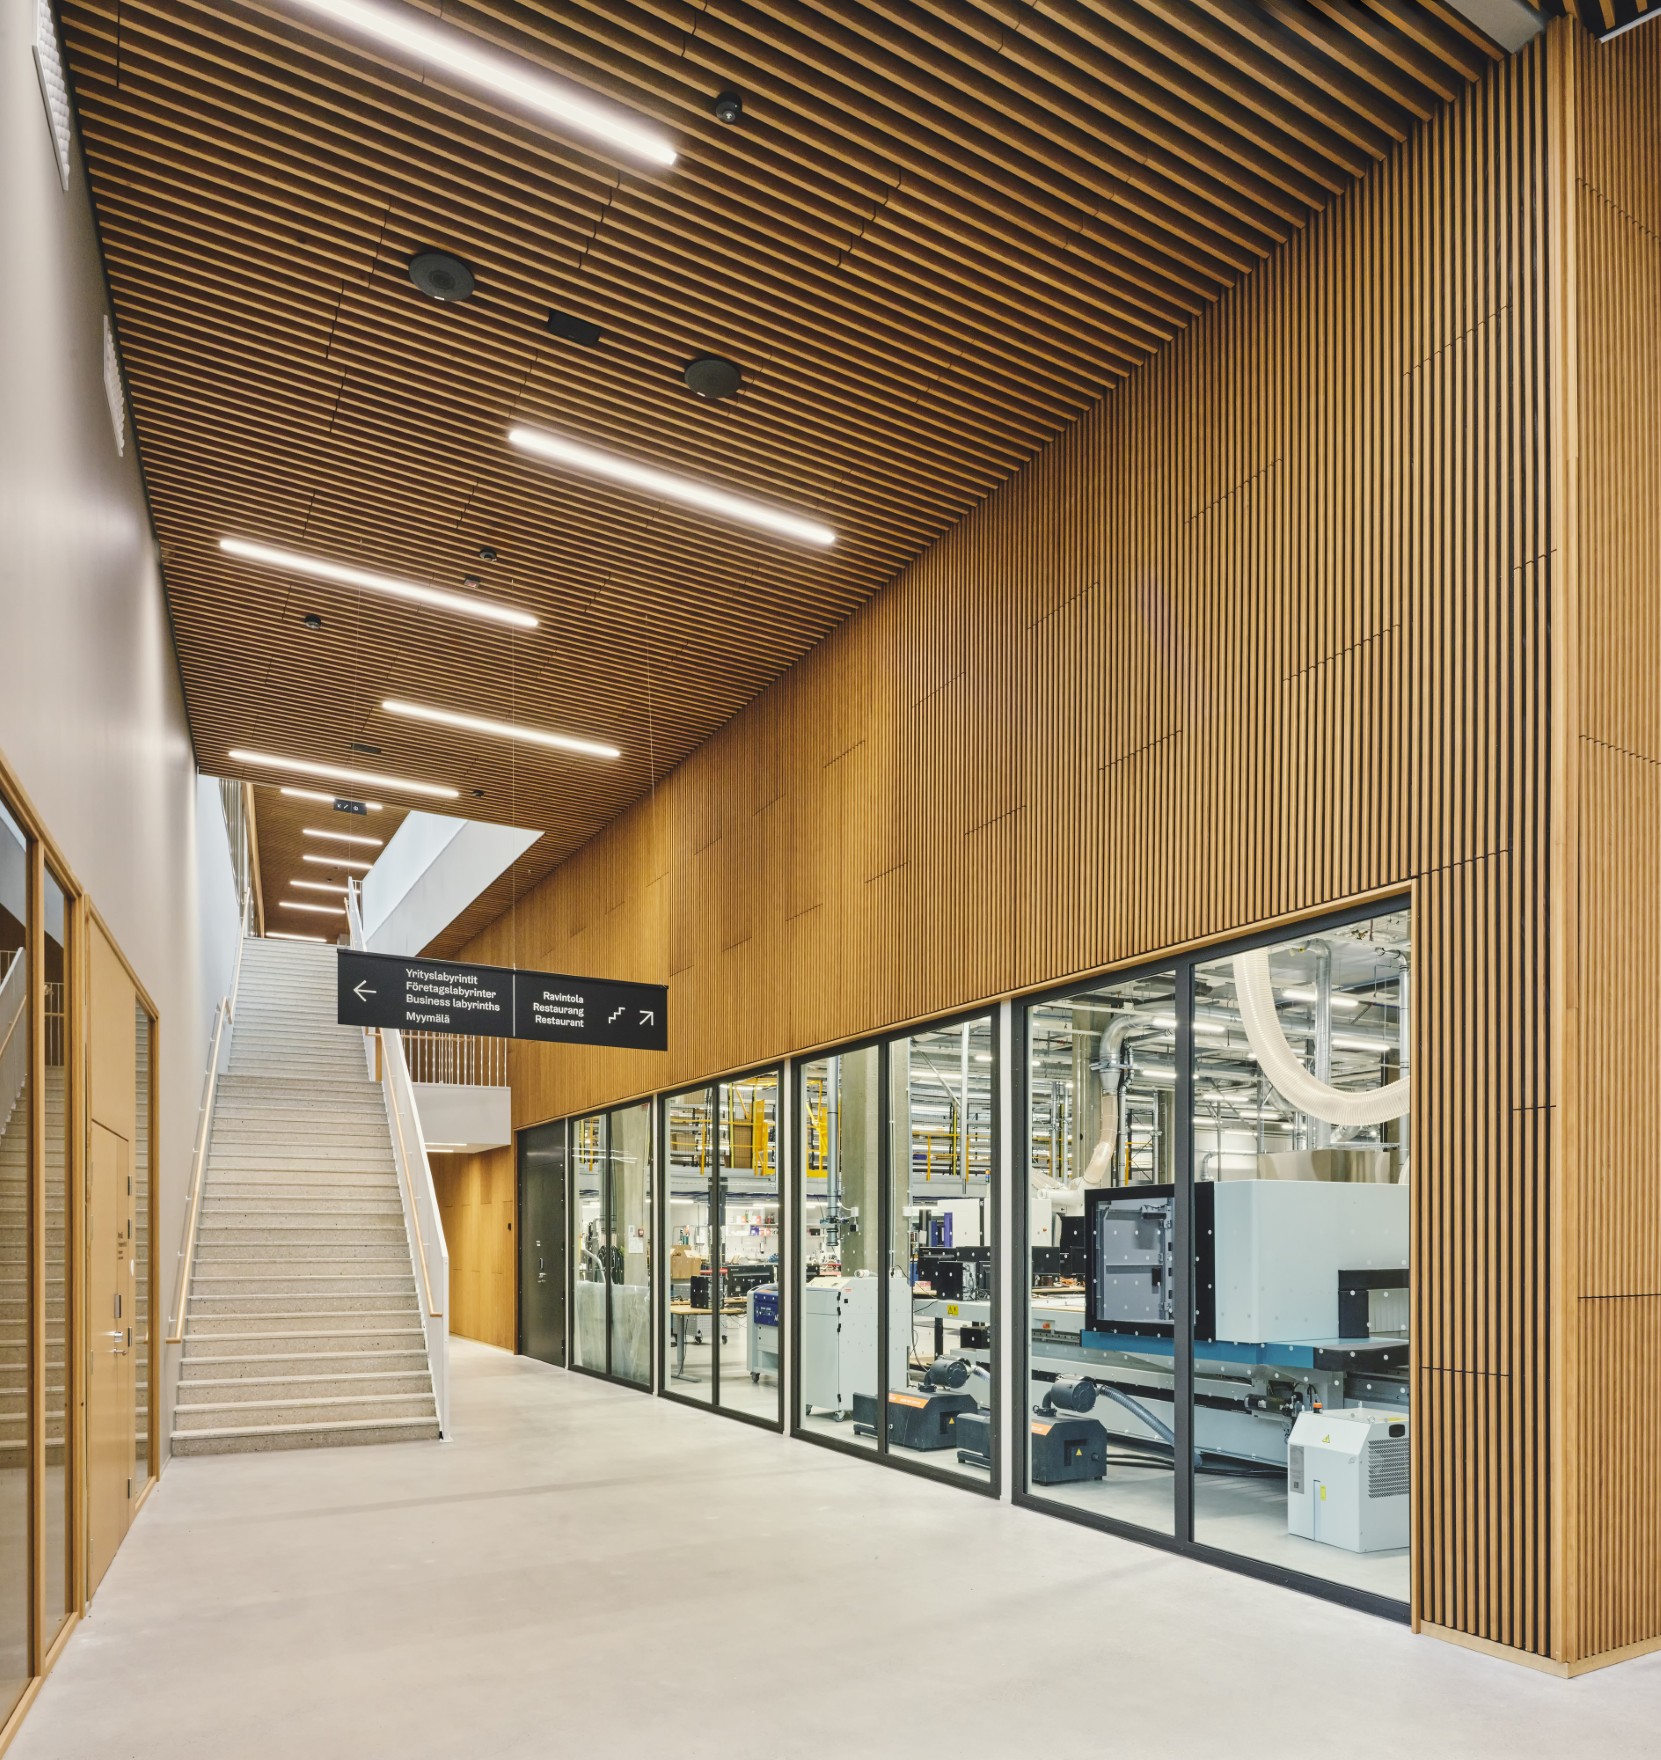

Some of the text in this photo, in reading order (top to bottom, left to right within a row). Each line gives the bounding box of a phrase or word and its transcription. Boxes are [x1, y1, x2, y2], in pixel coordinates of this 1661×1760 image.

[406, 968, 478, 985] Yrityslabyrintit
[406, 981, 497, 999] Företagslabyrinter
[543, 991, 584, 1004] Ravintola
[406, 994, 501, 1012] Business labyrinths
[533, 1002, 584, 1018] Restaurang
[406, 1011, 450, 1024] Myymälä
[535, 1014, 584, 1028] Restaurant
